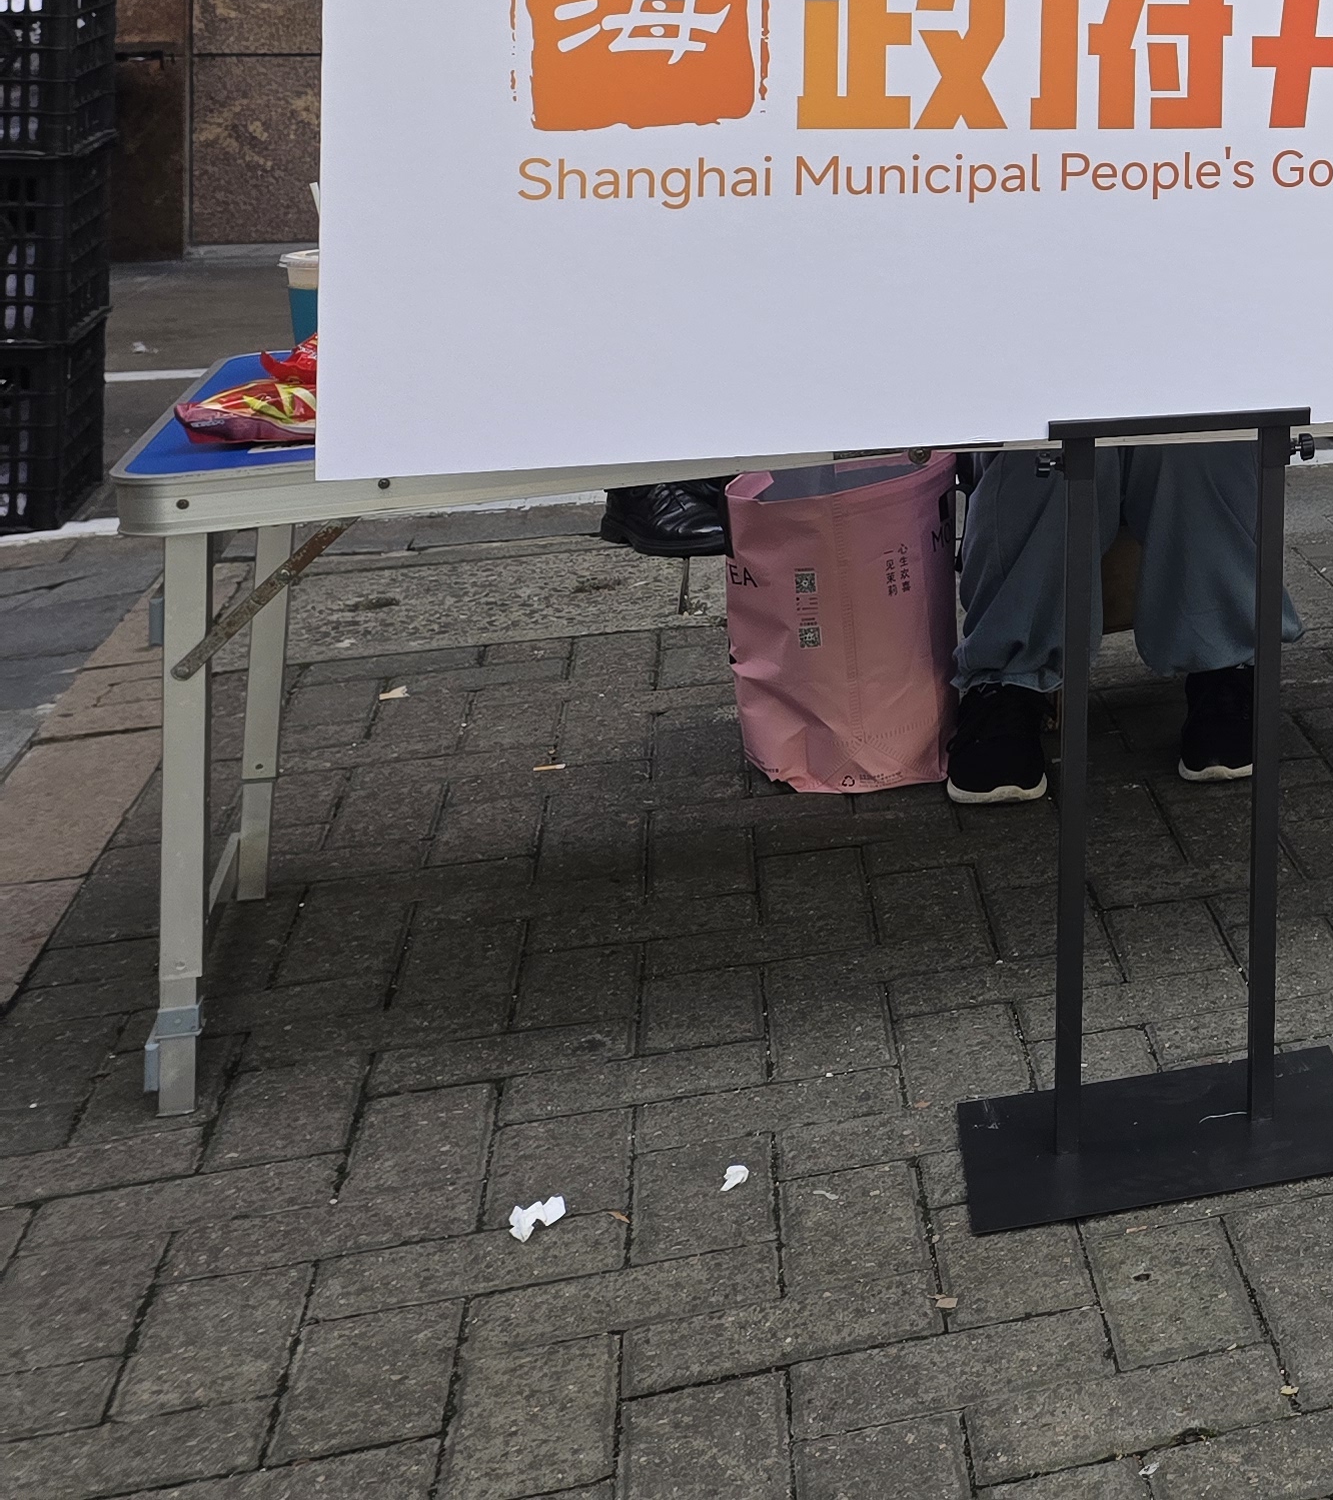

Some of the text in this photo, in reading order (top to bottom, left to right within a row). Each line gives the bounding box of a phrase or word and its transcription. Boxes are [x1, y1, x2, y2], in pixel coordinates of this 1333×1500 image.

[517, 155, 773, 209] Shanghai
[795, 153, 1041, 203] Municipal
[1060, 146, 1255, 200] People's
[883, 549, 898, 597] 一见茉莉
[897, 543, 912, 593] 心生欢喜
